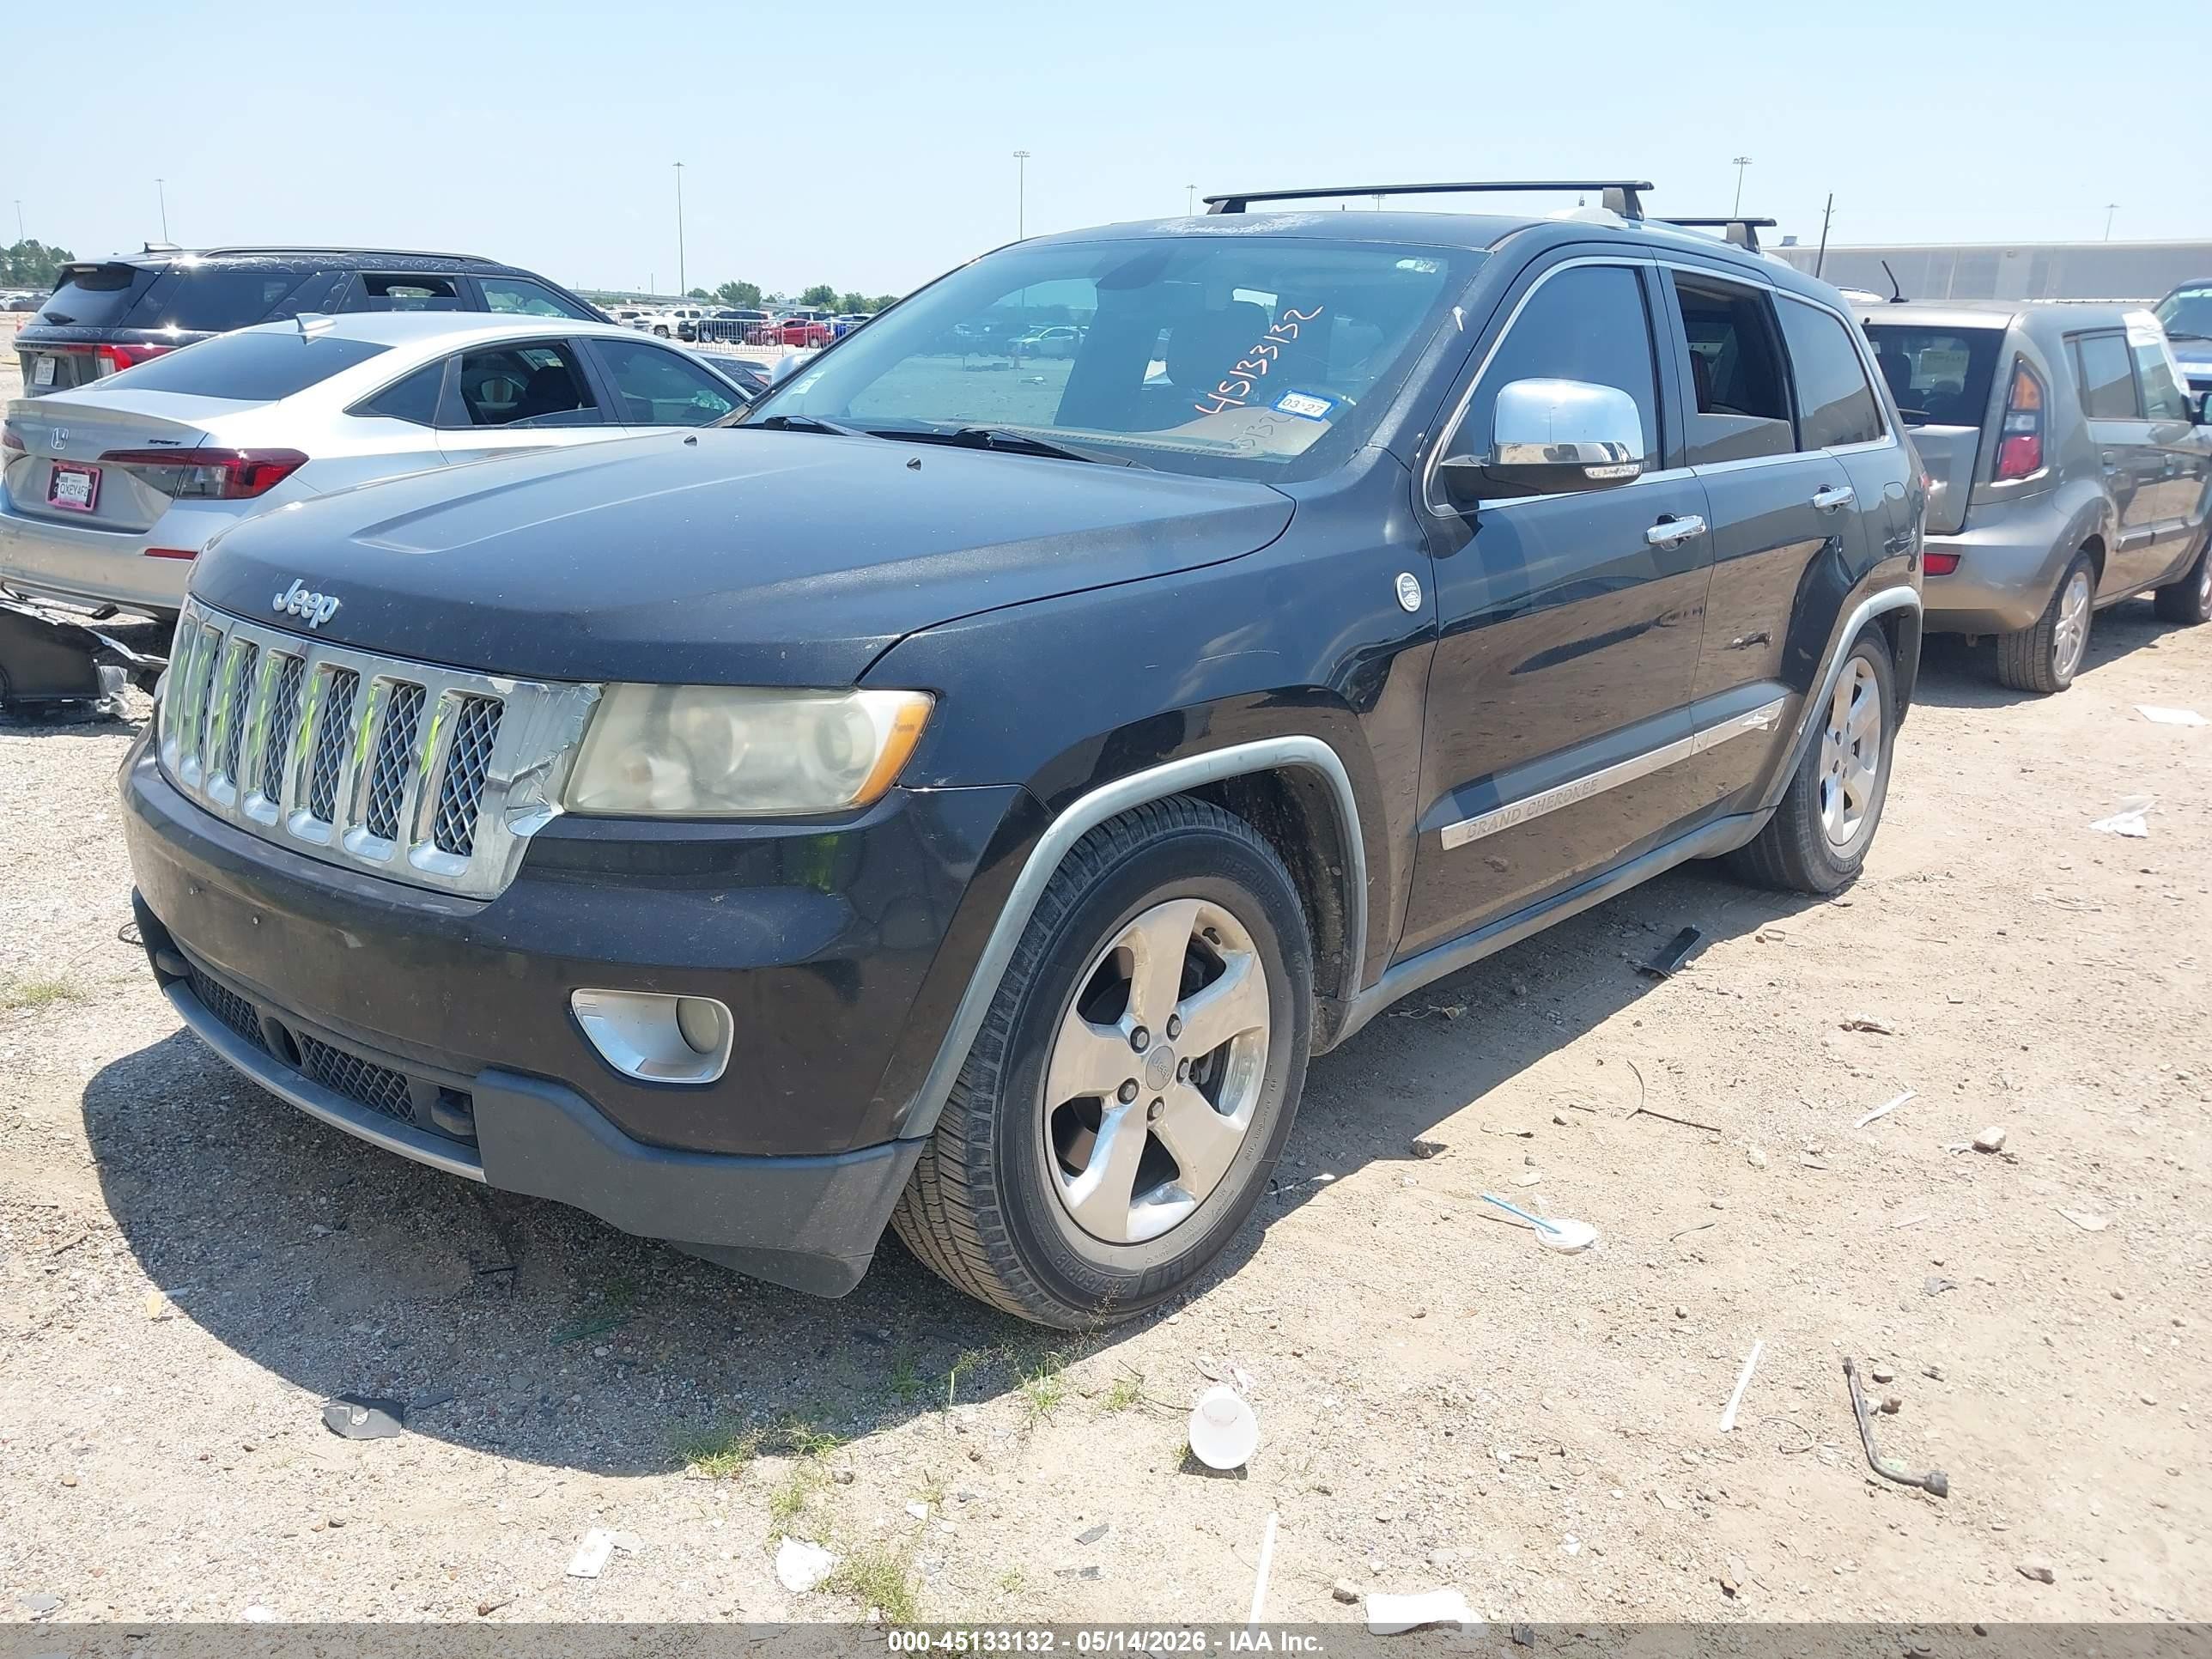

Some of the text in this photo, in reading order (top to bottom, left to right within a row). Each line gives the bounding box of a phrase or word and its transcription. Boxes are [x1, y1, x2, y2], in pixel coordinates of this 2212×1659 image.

[1194, 305, 1324, 415] 45133132
[272, 578, 340, 629] Jeep
[1467, 778, 1600, 839] GRAND CHEROKEE
[1221, 858, 1282, 910] DEFENDER
[1152, 1056, 1170, 1079] Jeep
